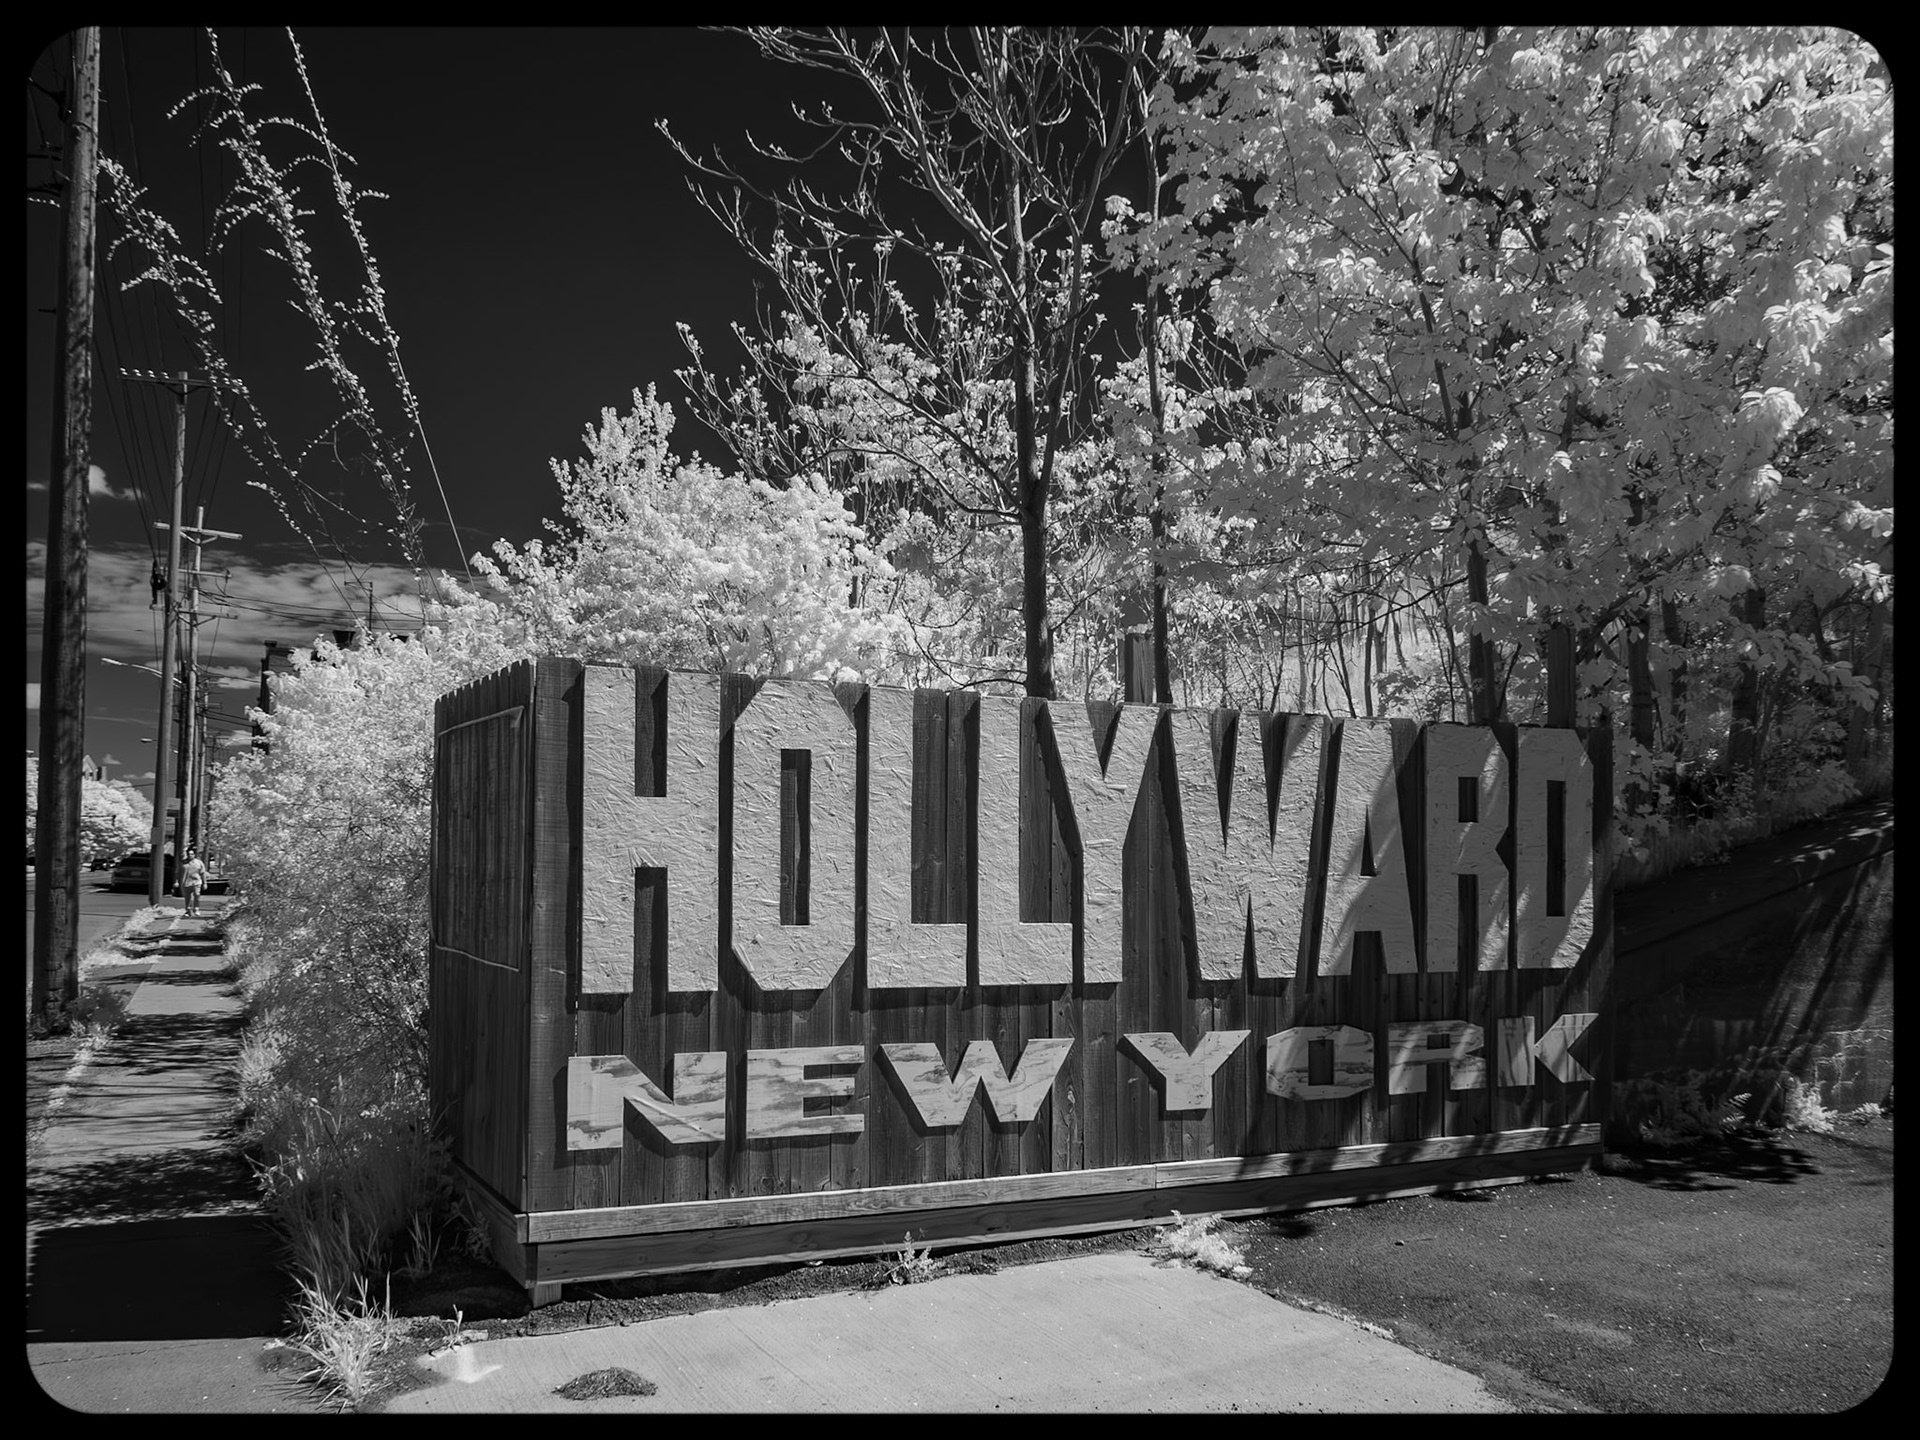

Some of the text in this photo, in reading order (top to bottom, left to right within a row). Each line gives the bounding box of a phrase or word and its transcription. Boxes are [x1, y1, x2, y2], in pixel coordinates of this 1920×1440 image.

[580, 664, 1595, 994] HOLLYWARD
[566, 1012, 1599, 1152] NEW YORK
